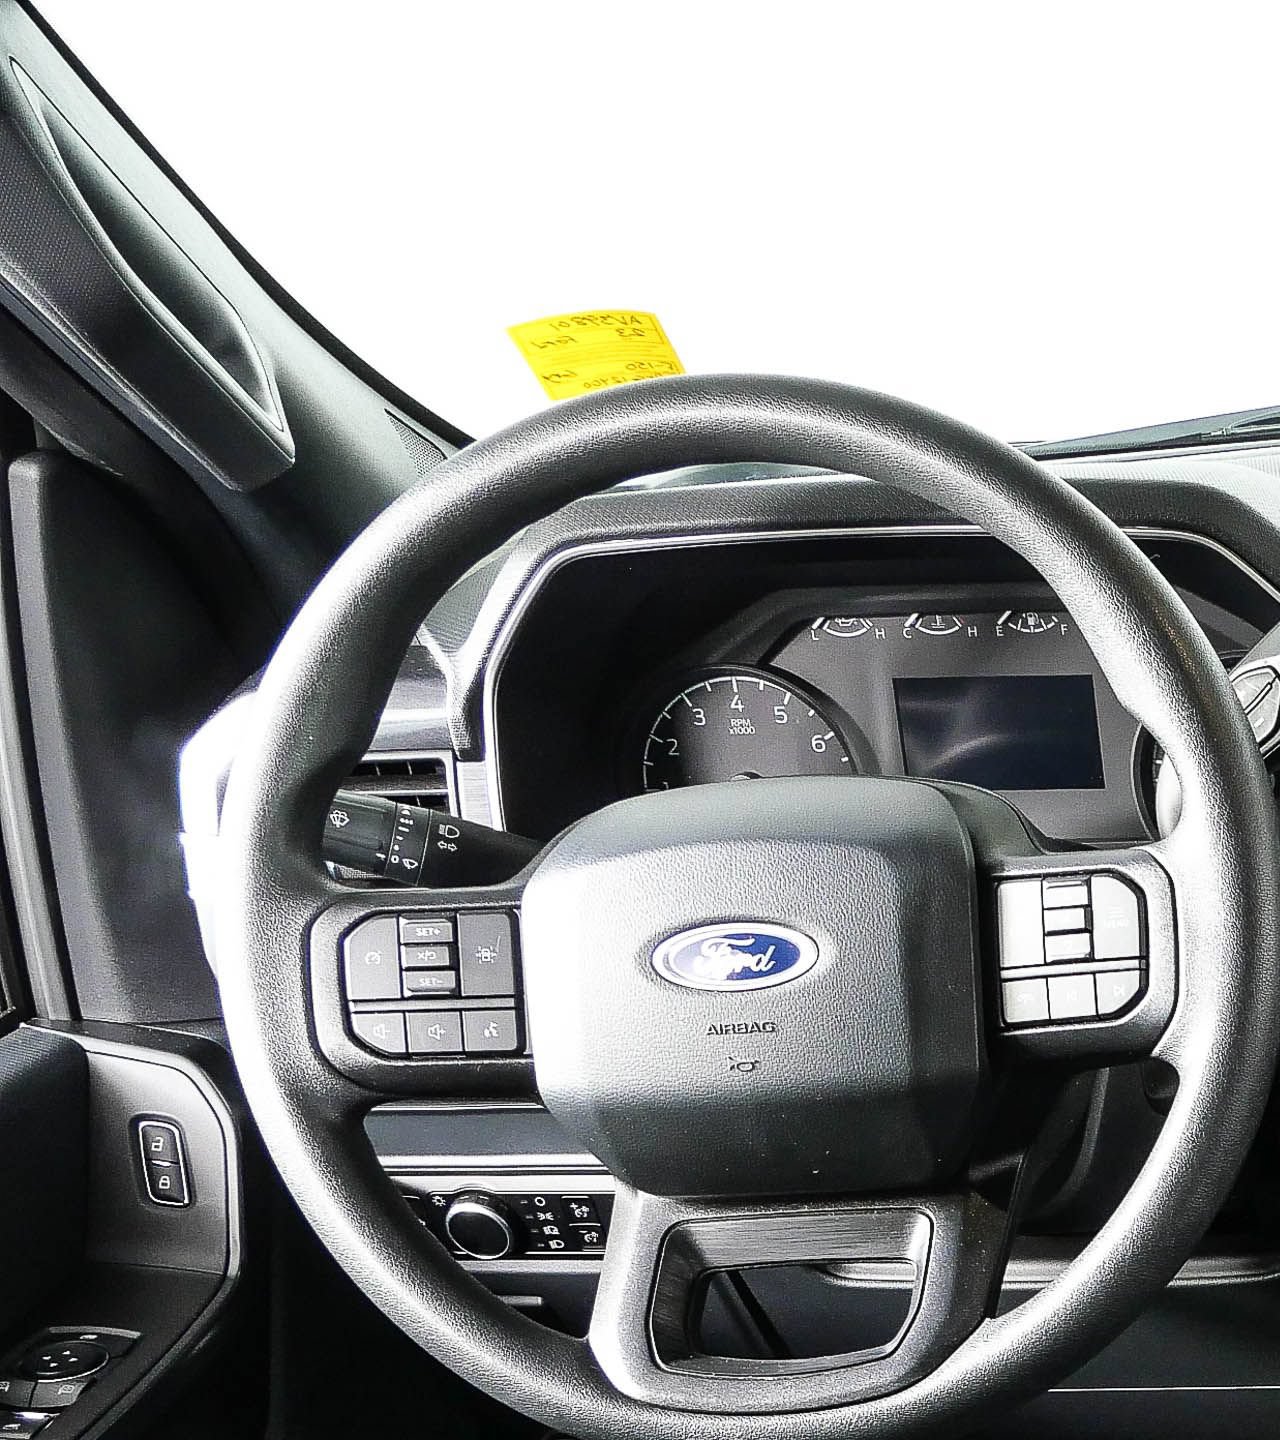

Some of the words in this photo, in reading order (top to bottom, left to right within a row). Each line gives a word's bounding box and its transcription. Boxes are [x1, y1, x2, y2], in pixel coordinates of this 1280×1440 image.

[811, 629, 819, 641] L
[874, 628, 886, 639] H
[903, 628, 912, 639] C
[967, 626, 978, 638] H
[996, 625, 1004, 637] E
[1061, 624, 1069, 636] F
[730, 694, 745, 713] 4
[692, 708, 706, 727] 3
[773, 705, 788, 725] 5
[730, 718, 752, 728] RPM
[666, 738, 680, 756] 2
[811, 735, 826, 753] 6
[692, 933, 777, 980] Ford
[705, 1021, 778, 1036] AIRBAG
